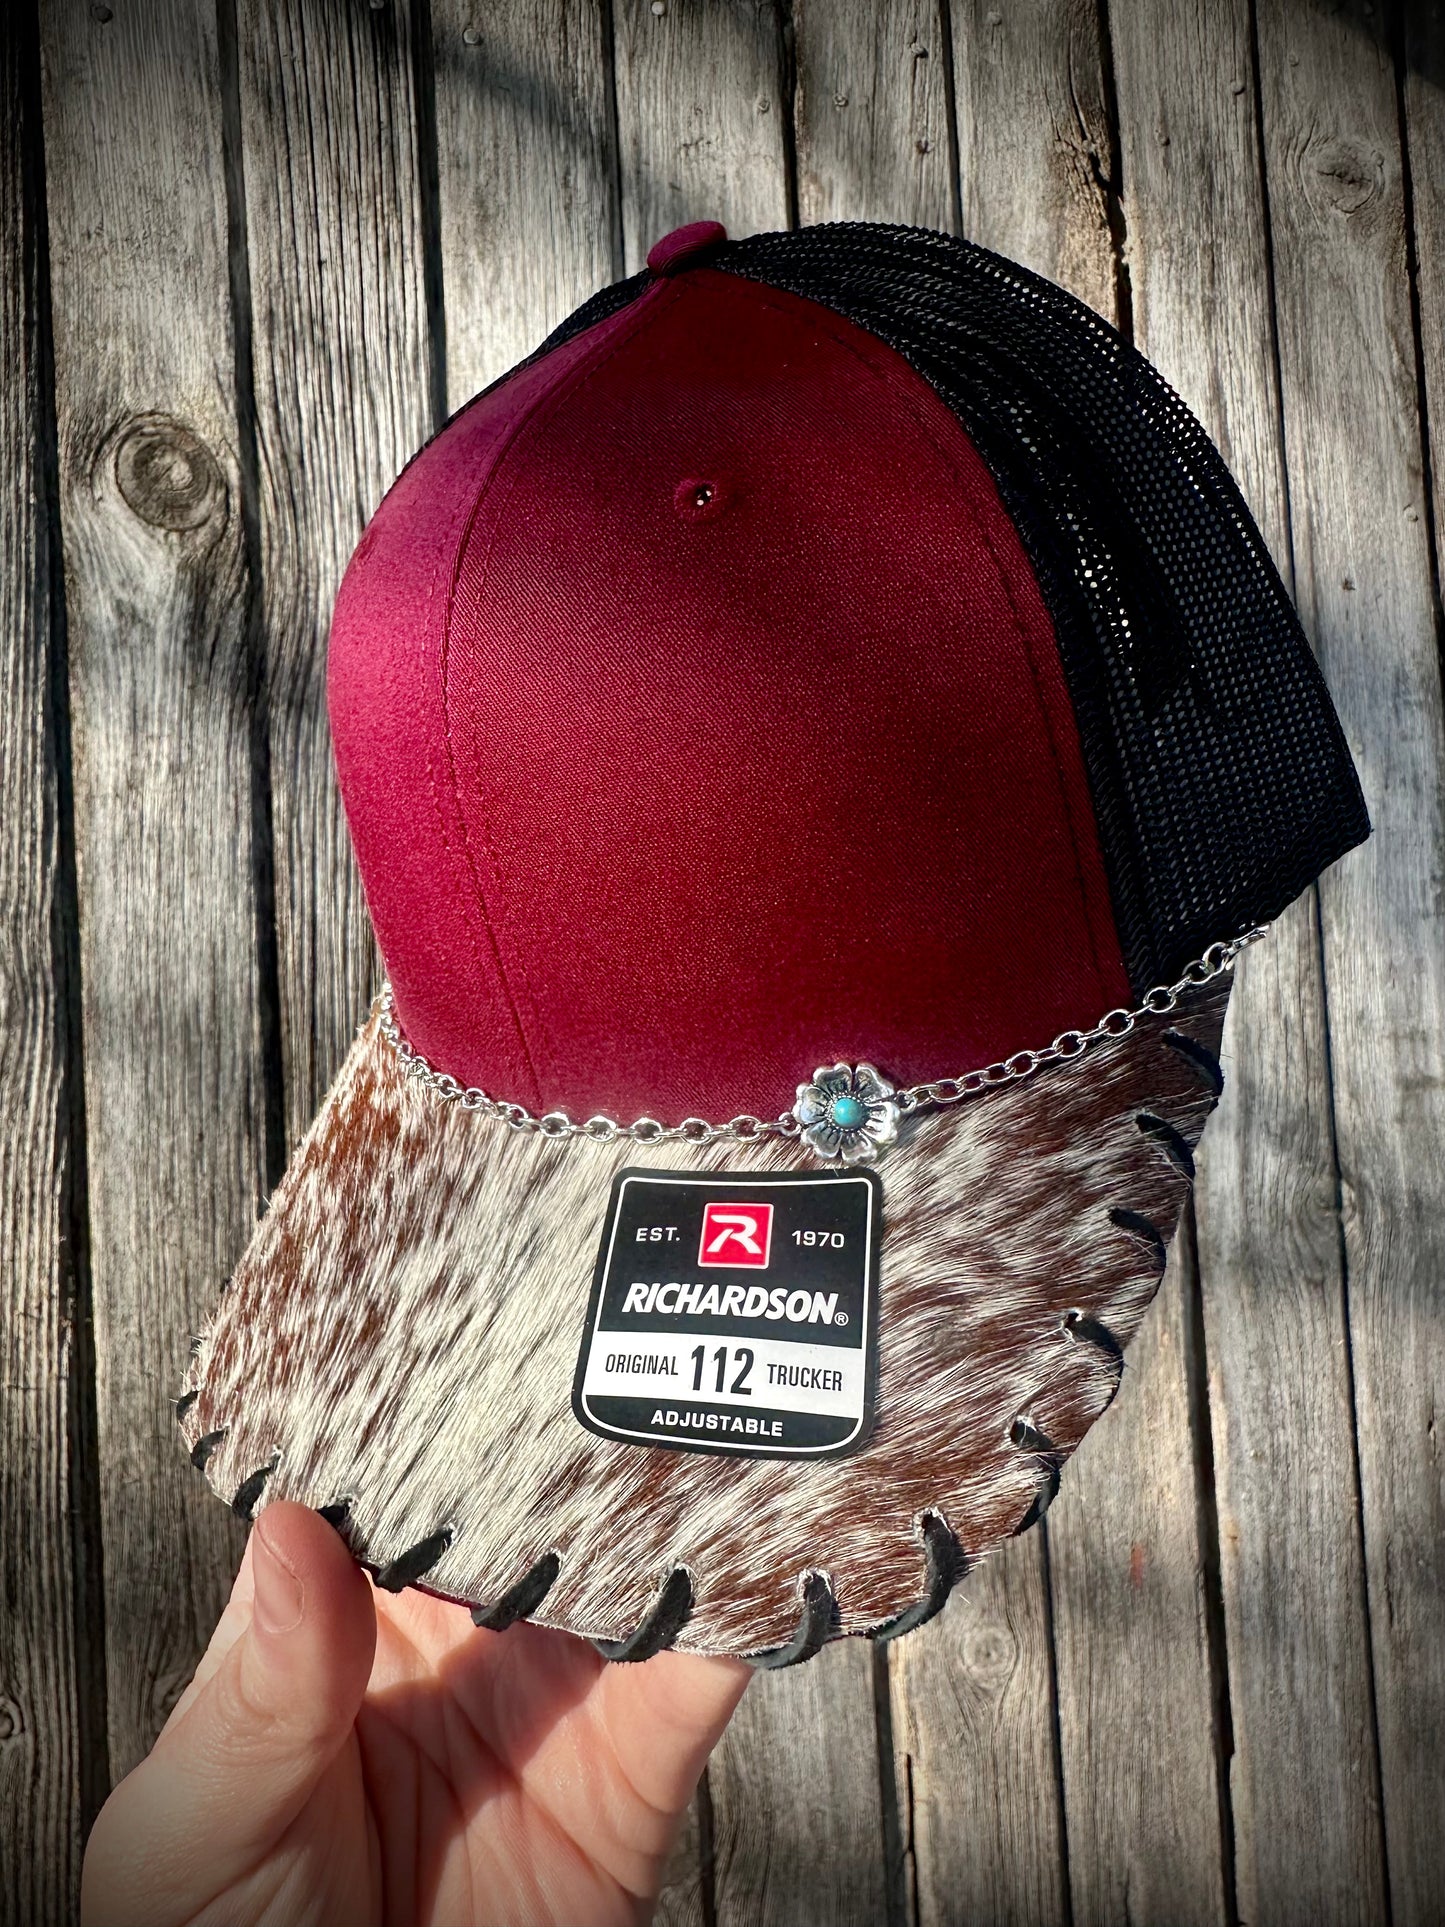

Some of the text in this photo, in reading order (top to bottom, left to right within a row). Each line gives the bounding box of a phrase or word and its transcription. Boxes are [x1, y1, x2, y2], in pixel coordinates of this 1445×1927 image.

[635, 1226, 681, 1242] EST.
[791, 1230, 845, 1248] 1970
[605, 1345, 842, 1395] ORIGINAL 112 TRUCKER
[650, 1409, 783, 1437] ADJUSTABLE
